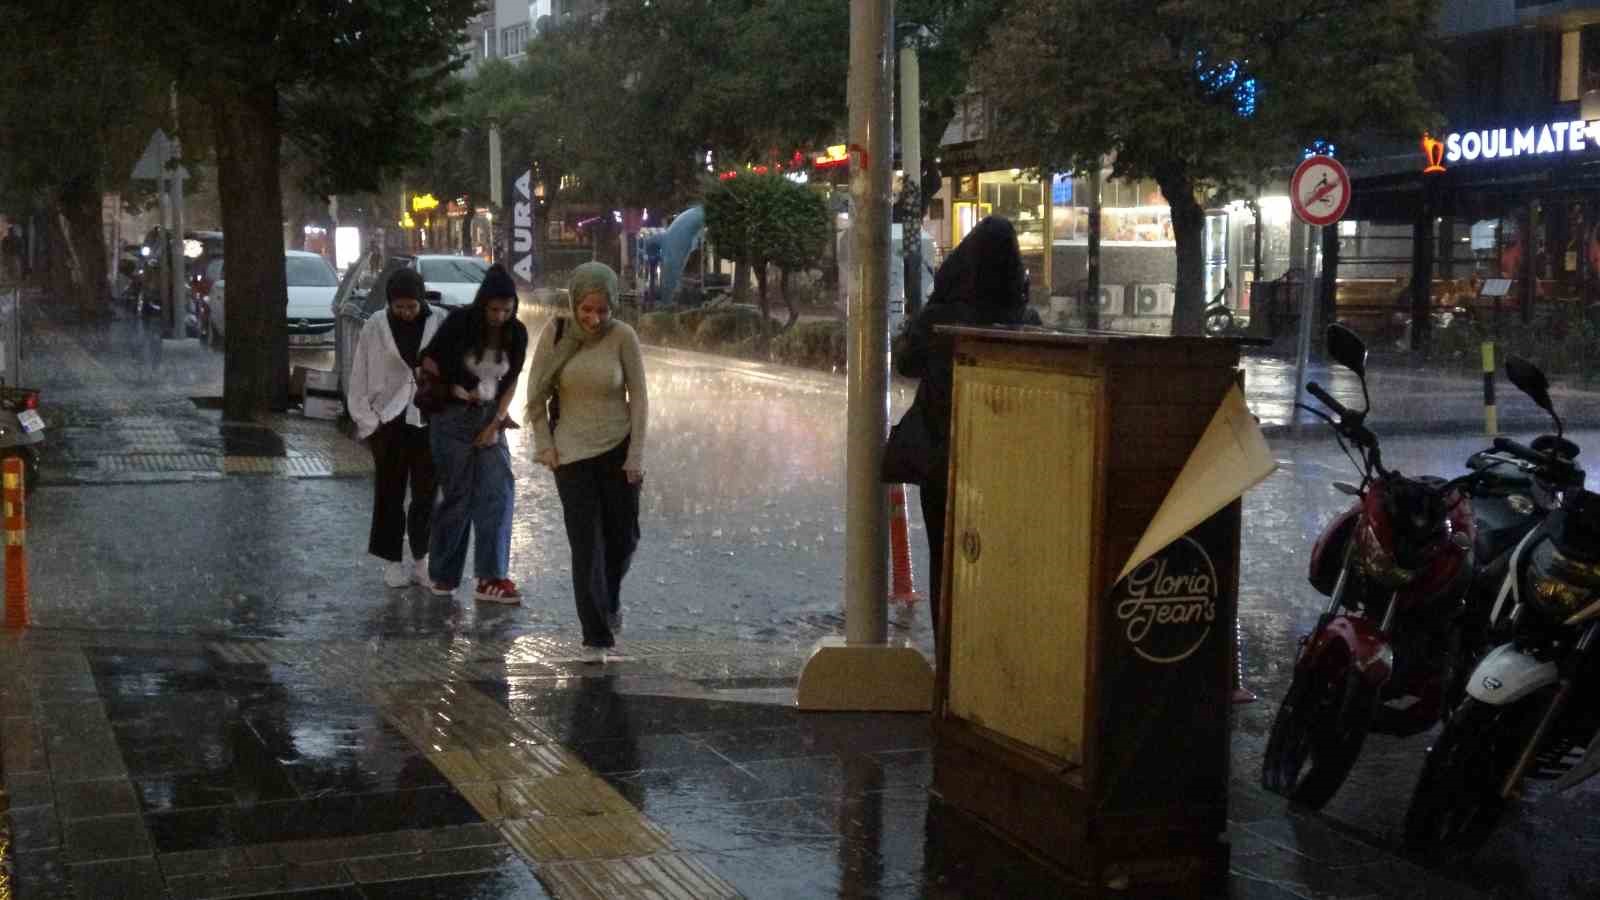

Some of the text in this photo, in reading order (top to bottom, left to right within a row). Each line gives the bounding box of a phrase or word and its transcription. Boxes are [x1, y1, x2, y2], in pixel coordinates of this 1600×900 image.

[1447, 121, 1585, 160] SOULMATE
[513, 169, 532, 282] AURA
[1117, 559, 1209, 617] Gloria
[1127, 602, 1215, 641] Jean's
